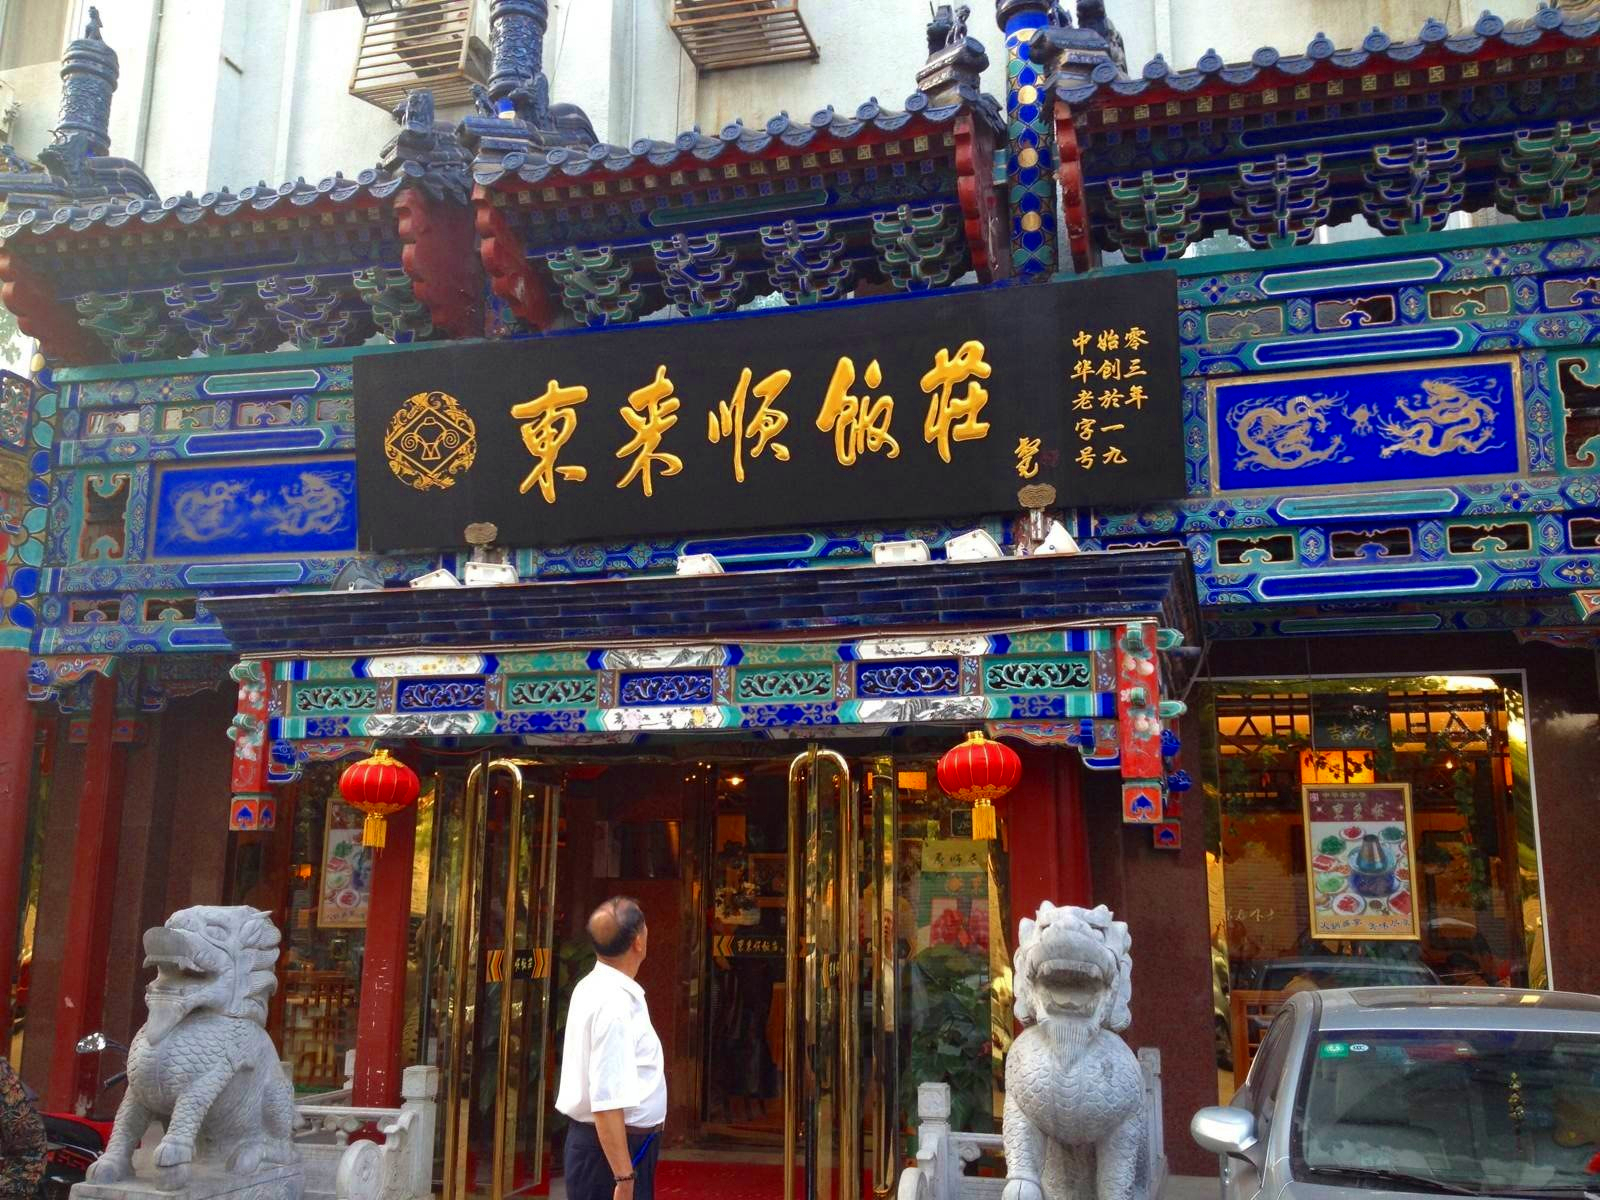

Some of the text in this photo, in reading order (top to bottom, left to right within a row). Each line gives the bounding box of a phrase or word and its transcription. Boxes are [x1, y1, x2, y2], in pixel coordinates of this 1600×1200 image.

[1071, 330, 1097, 470] 中华老字号
[1123, 327, 1149, 409] 零三年
